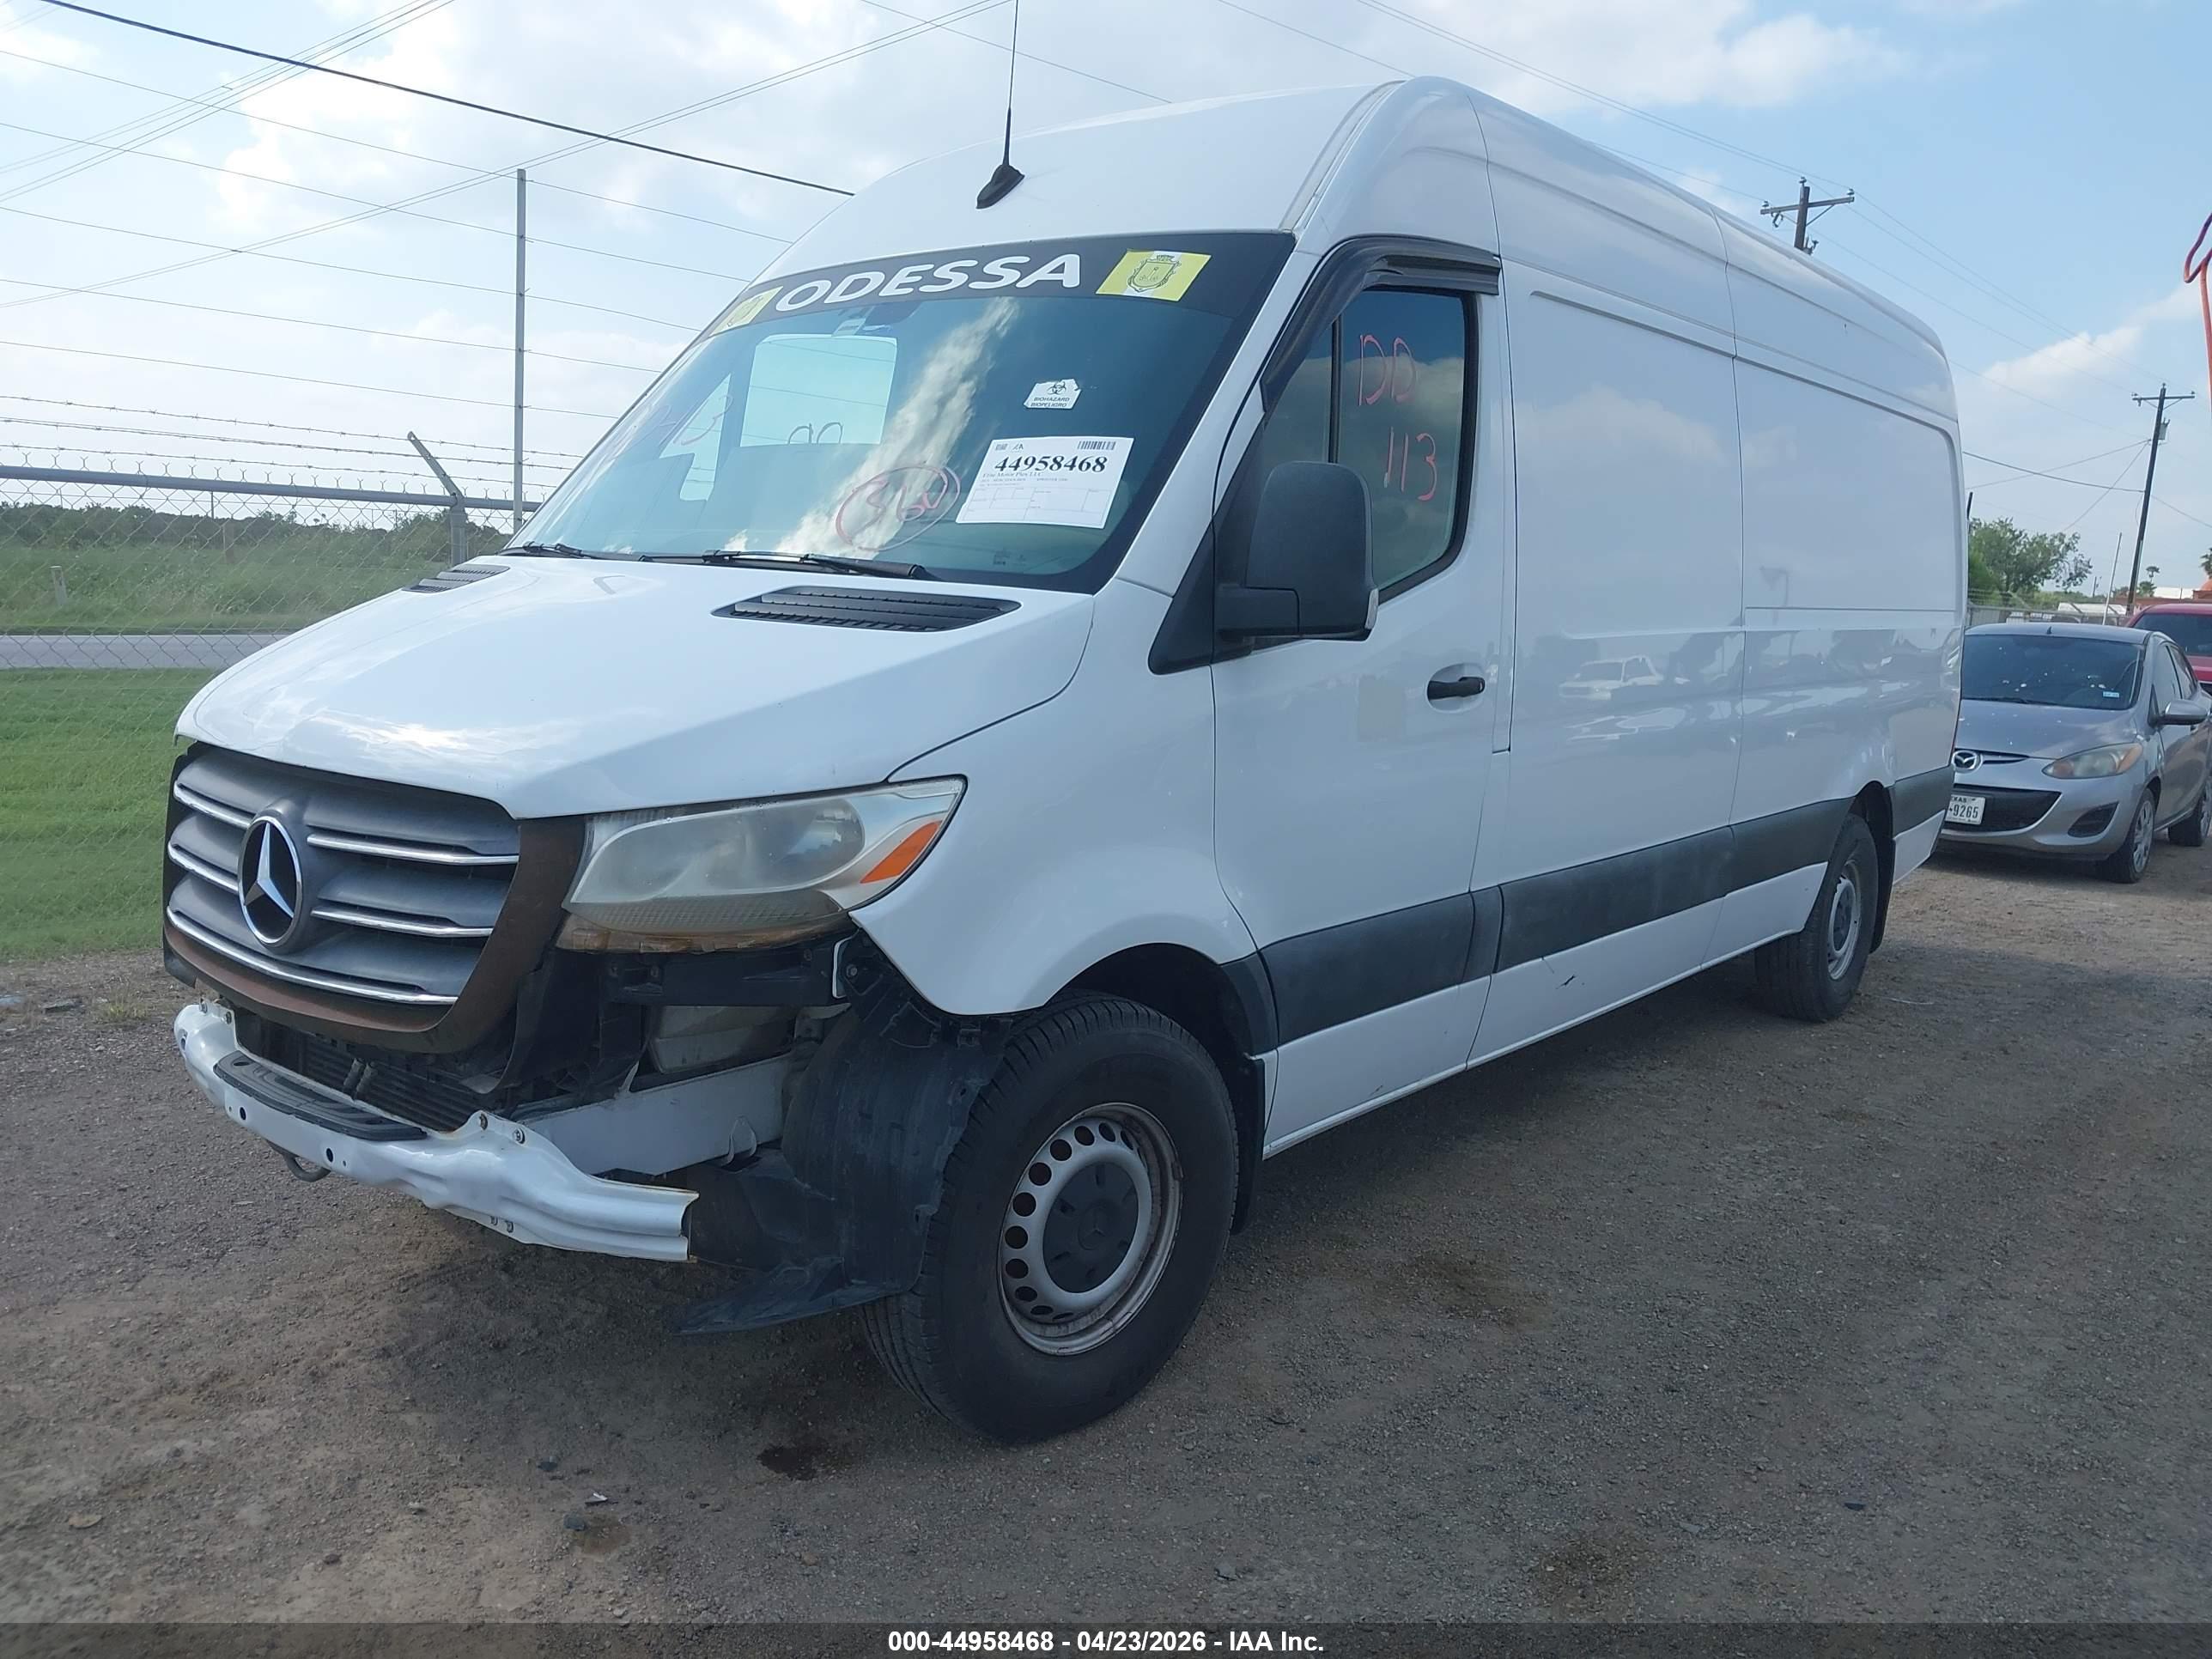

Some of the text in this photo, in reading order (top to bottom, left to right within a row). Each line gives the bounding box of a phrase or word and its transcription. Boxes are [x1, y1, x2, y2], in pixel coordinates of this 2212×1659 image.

[775, 254, 1080, 312] ODESSA
[995, 455, 1109, 472] 44958468
[1382, 426, 1437, 501] 113
[1953, 804, 1979, 818] 9265
